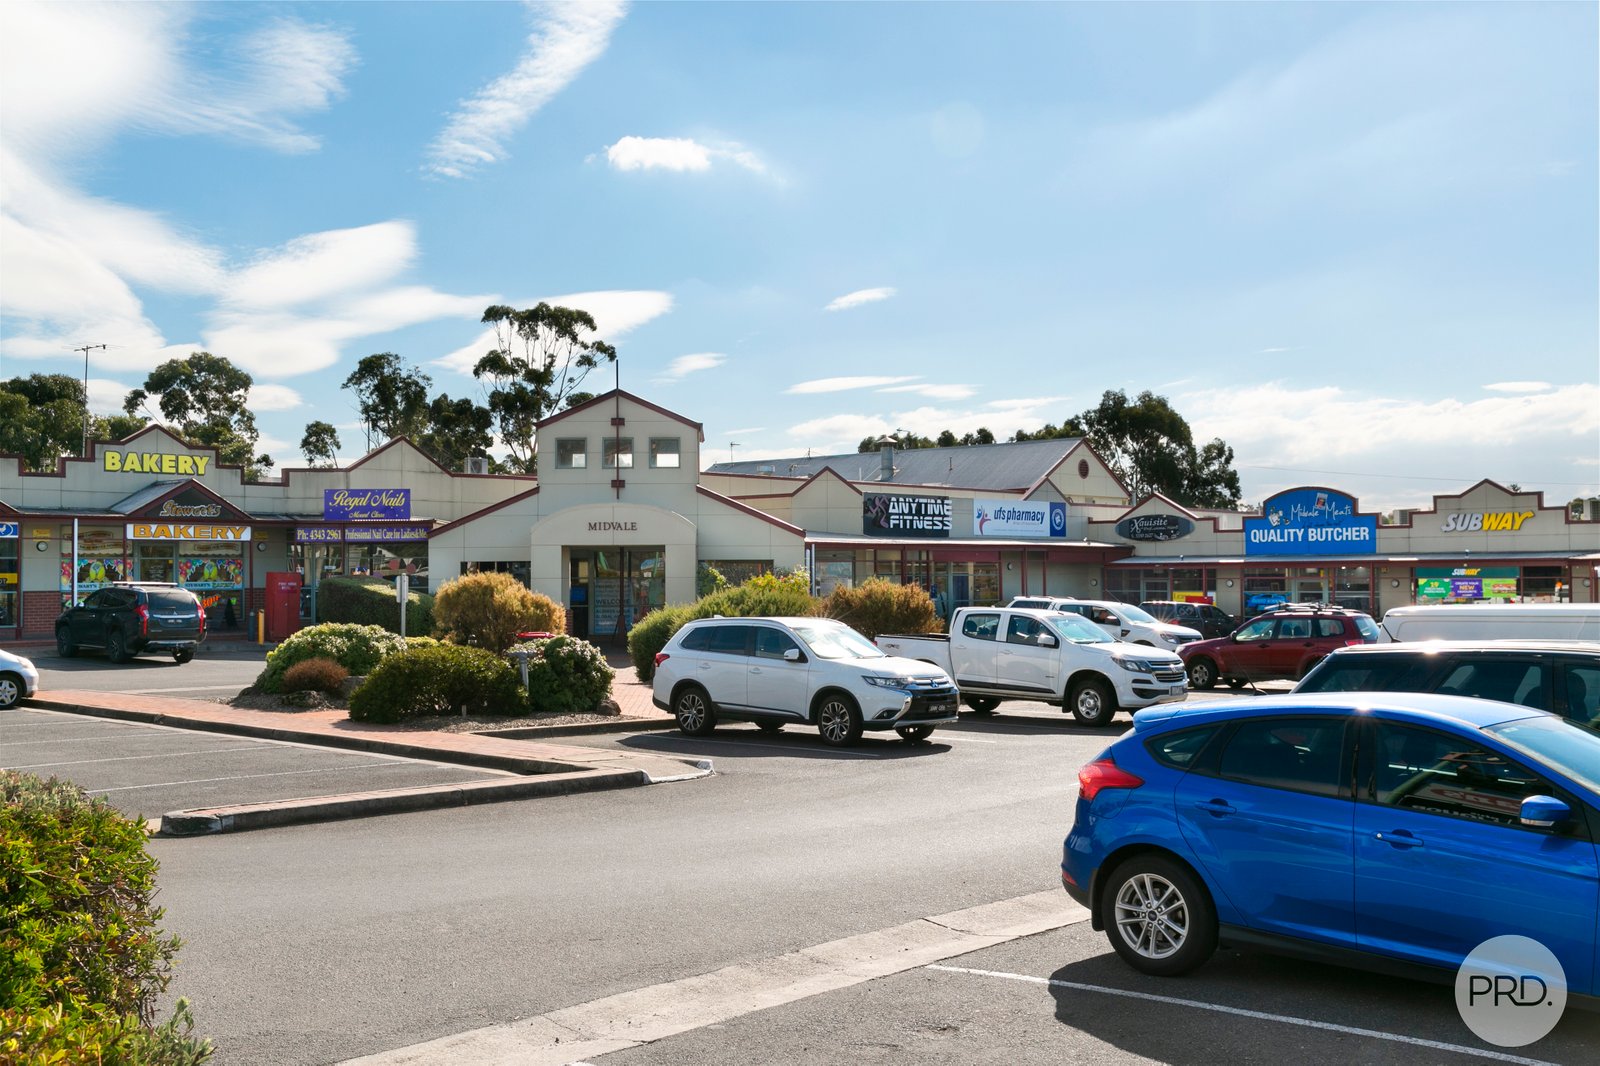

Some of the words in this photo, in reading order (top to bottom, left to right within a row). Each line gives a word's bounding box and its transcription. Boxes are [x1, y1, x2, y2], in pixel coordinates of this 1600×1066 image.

[104, 450, 210, 476] BAKERY
[329, 489, 371, 510] Regal
[371, 489, 405, 508] Nails
[888, 496, 953, 516] ANYTIME
[994, 506, 1006, 520] ufs
[1006, 507, 1046, 524] pharmacy
[1290, 502, 1320, 522] Midvale
[1325, 501, 1352, 521] Meats
[588, 522, 638, 532] MIDVALE
[890, 515, 953, 530] FITNESS
[1440, 510, 1535, 532] SUBWAY
[133, 524, 246, 539] BAKERY
[297, 529, 309, 540] Ph:
[345, 528, 371, 540] Professional
[372, 529, 382, 539] Nail
[383, 529, 393, 539] Care
[393, 529, 401, 539] for
[1251, 528, 1304, 543] QUALITY
[1308, 526, 1369, 542] BUTCHER
[1452, 568, 1481, 576] SUBWAY
